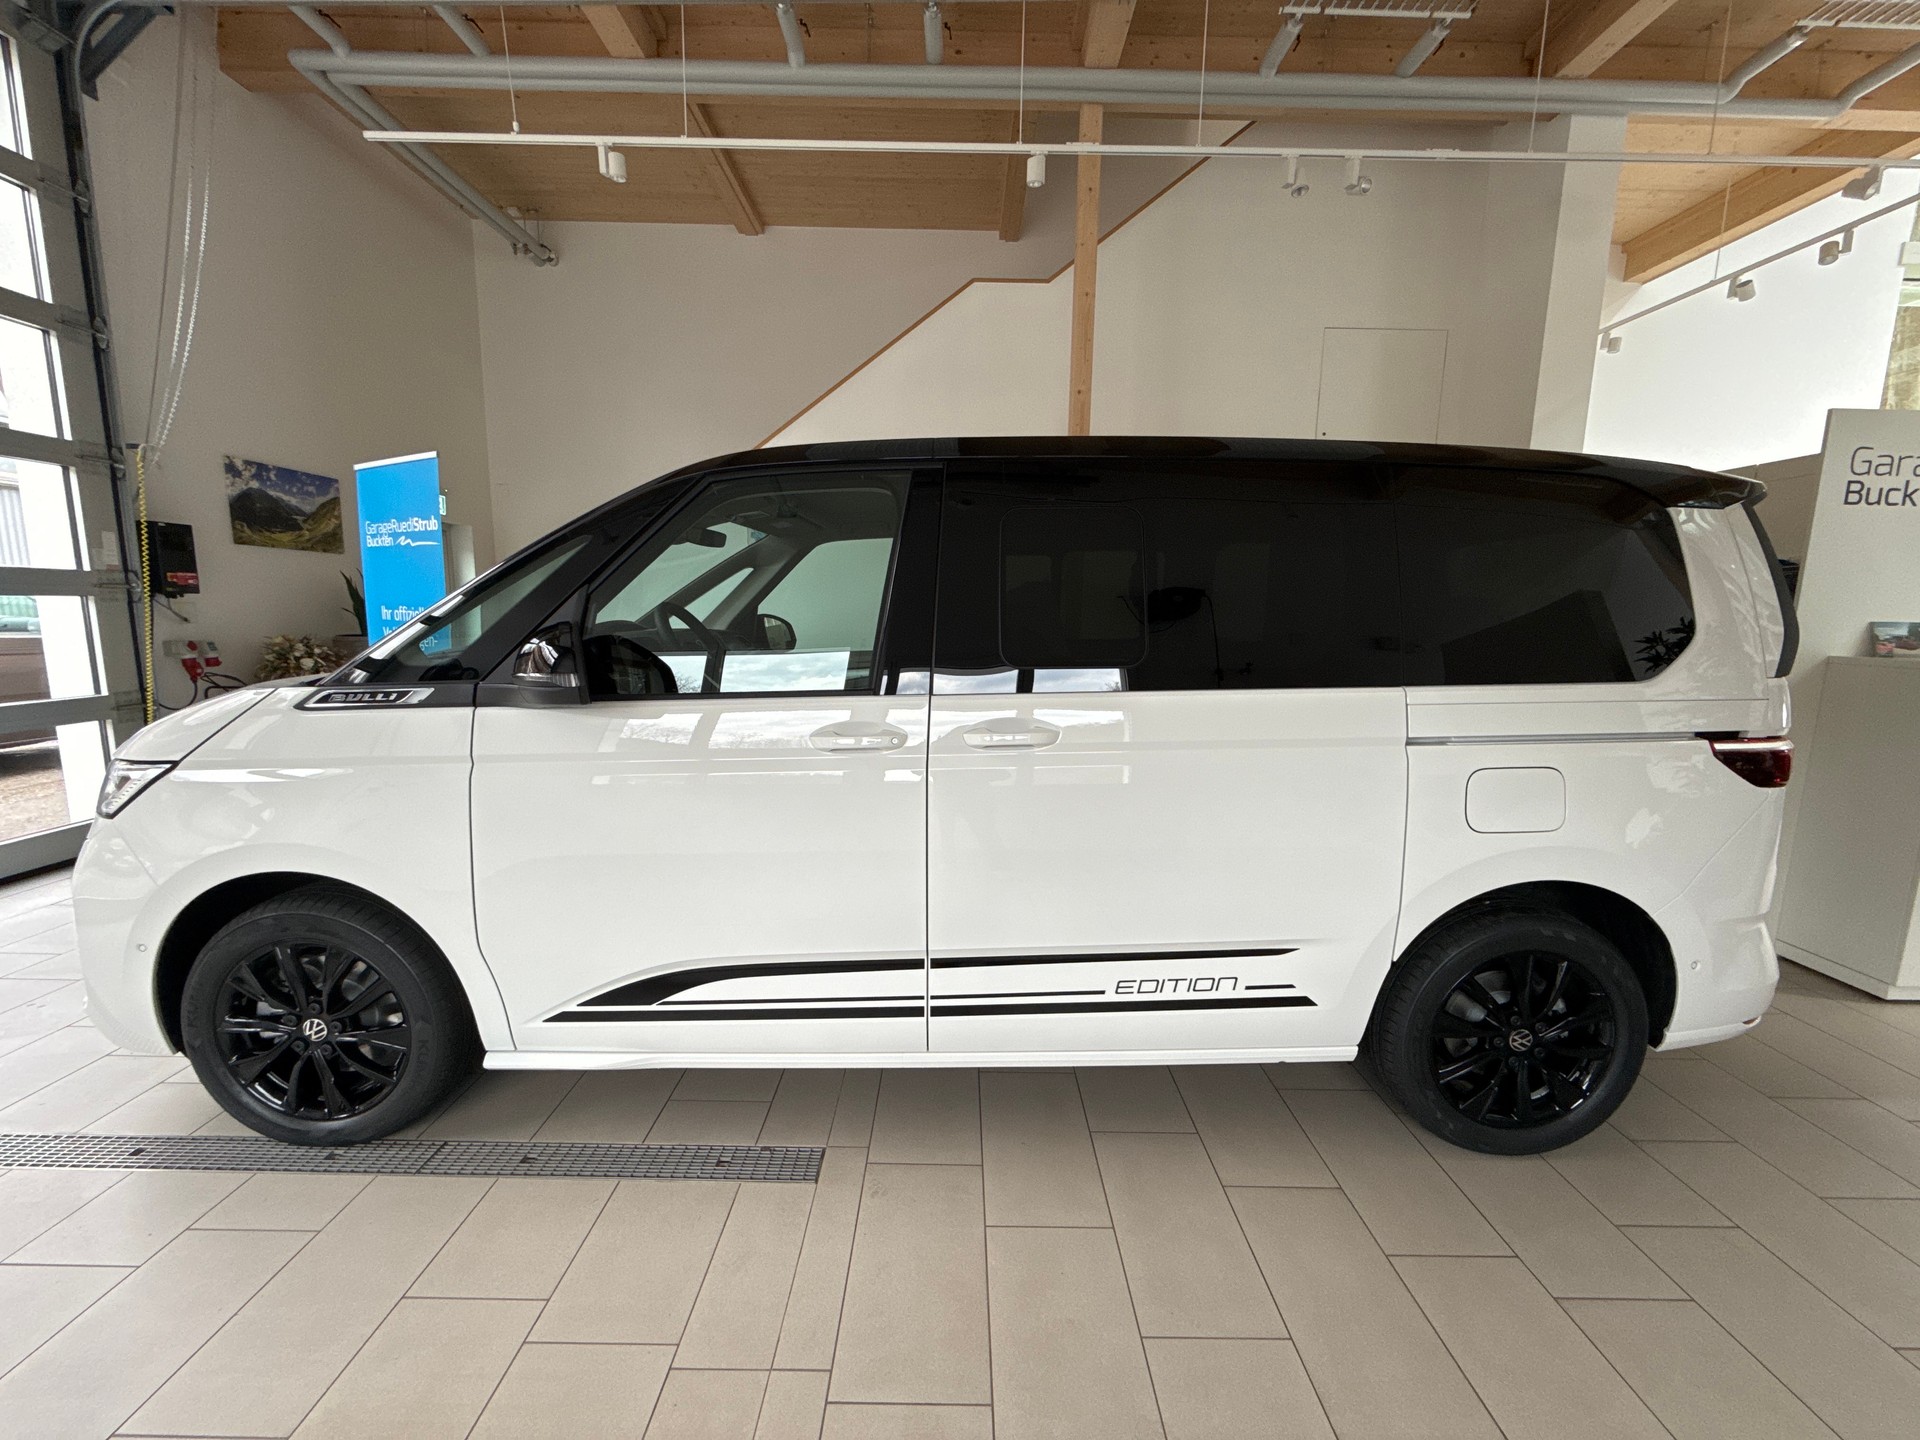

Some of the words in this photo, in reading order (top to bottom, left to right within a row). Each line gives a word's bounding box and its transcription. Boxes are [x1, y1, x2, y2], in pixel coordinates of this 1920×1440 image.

[1843, 479, 1920, 507] Buck
[366, 534, 395, 547] Buckten
[381, 605, 393, 621] Ihr
[328, 692, 398, 702] BULLI
[1115, 976, 1238, 994] EDITION
